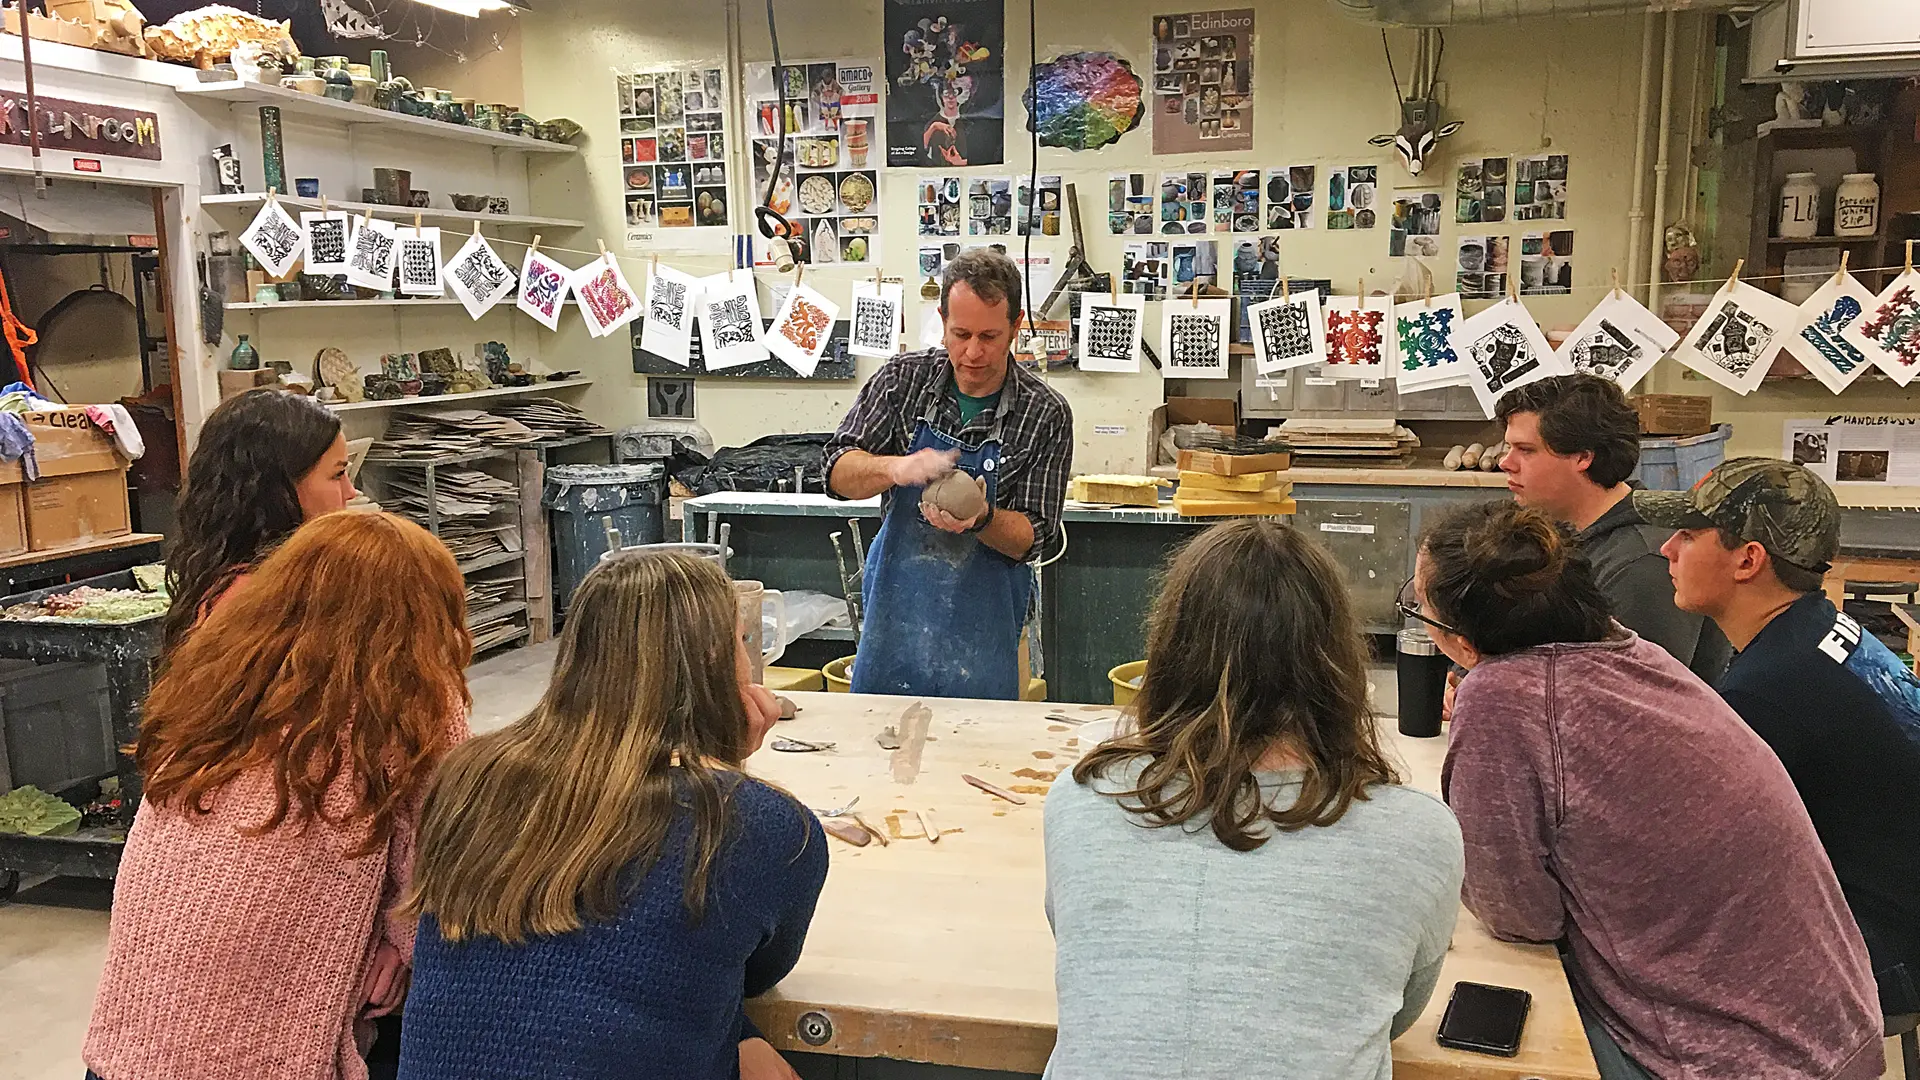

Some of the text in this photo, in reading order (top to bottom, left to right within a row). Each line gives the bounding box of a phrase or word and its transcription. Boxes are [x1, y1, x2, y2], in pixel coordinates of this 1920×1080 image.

[1191, 12, 1252, 30] Edinboro
[841, 69, 868, 81] AMACO
[627, 232, 653, 241] Ceramics
[1024, 334, 1067, 349] PTERY
[1843, 415, 1889, 426] HANDLES
